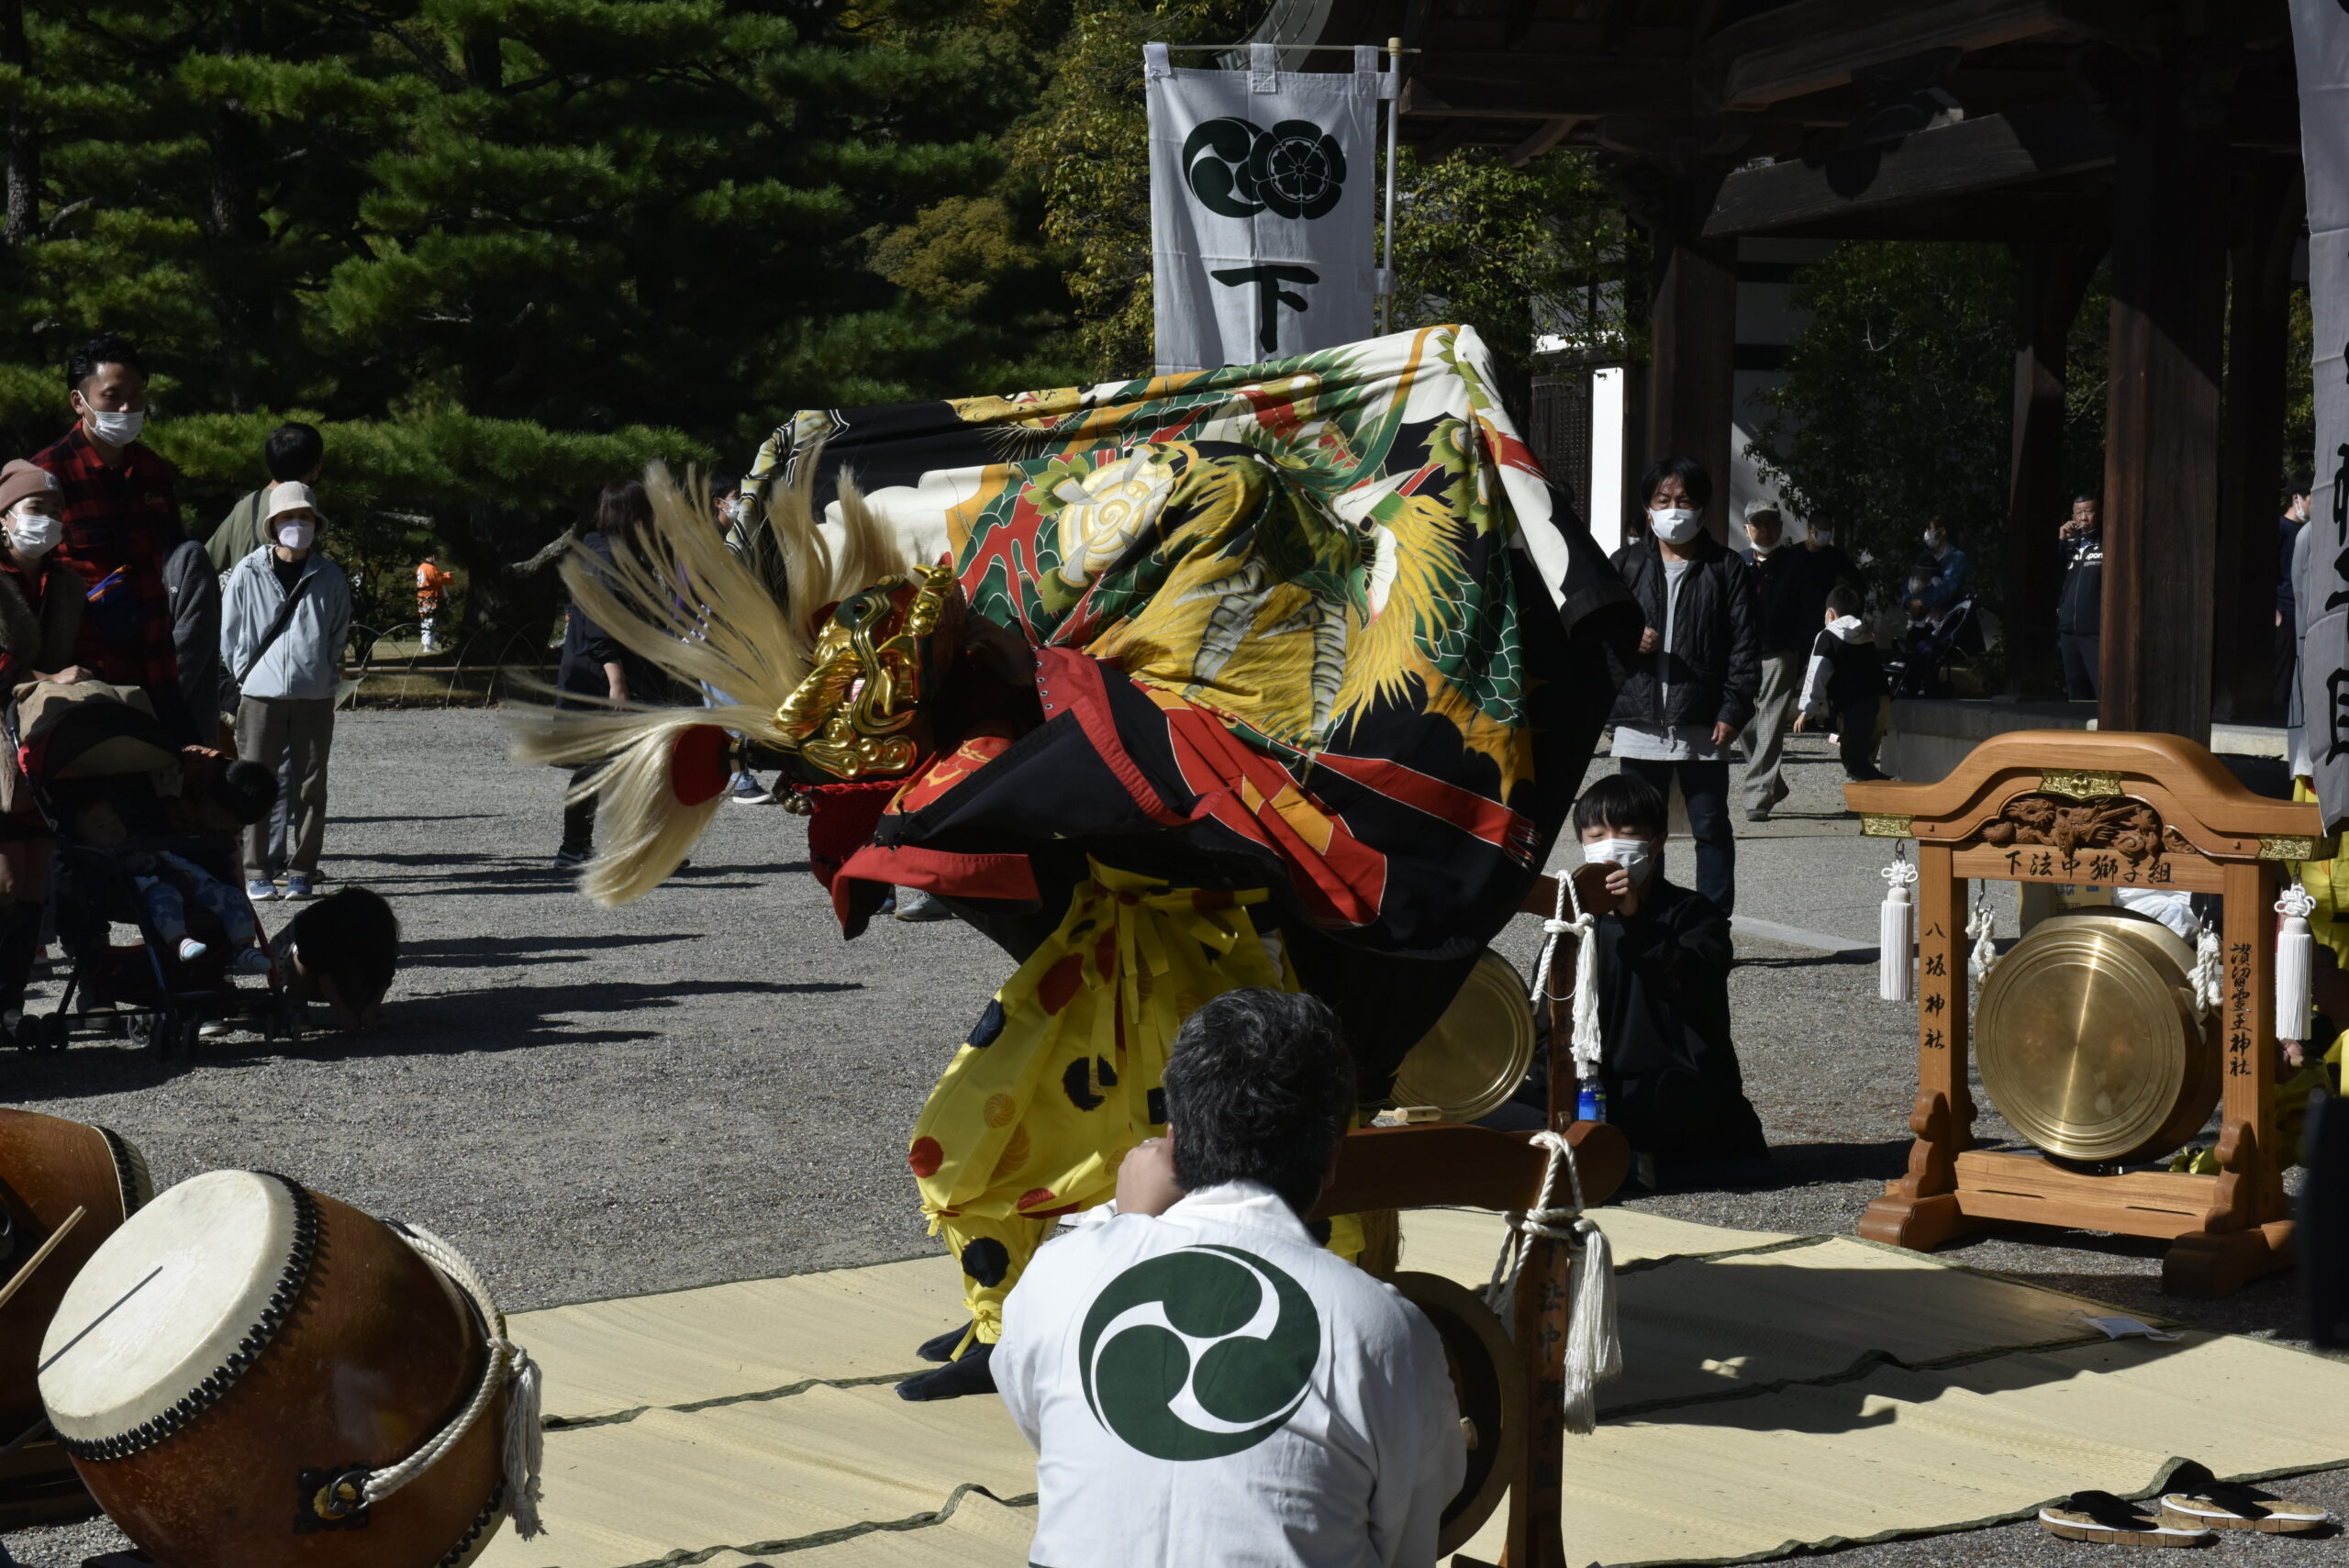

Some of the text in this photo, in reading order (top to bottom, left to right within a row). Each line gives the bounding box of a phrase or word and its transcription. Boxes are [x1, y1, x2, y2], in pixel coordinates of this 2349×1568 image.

[2005, 850, 2175, 884] 下法中獅子組
[1924, 921, 1947, 1050] 八坂神社
